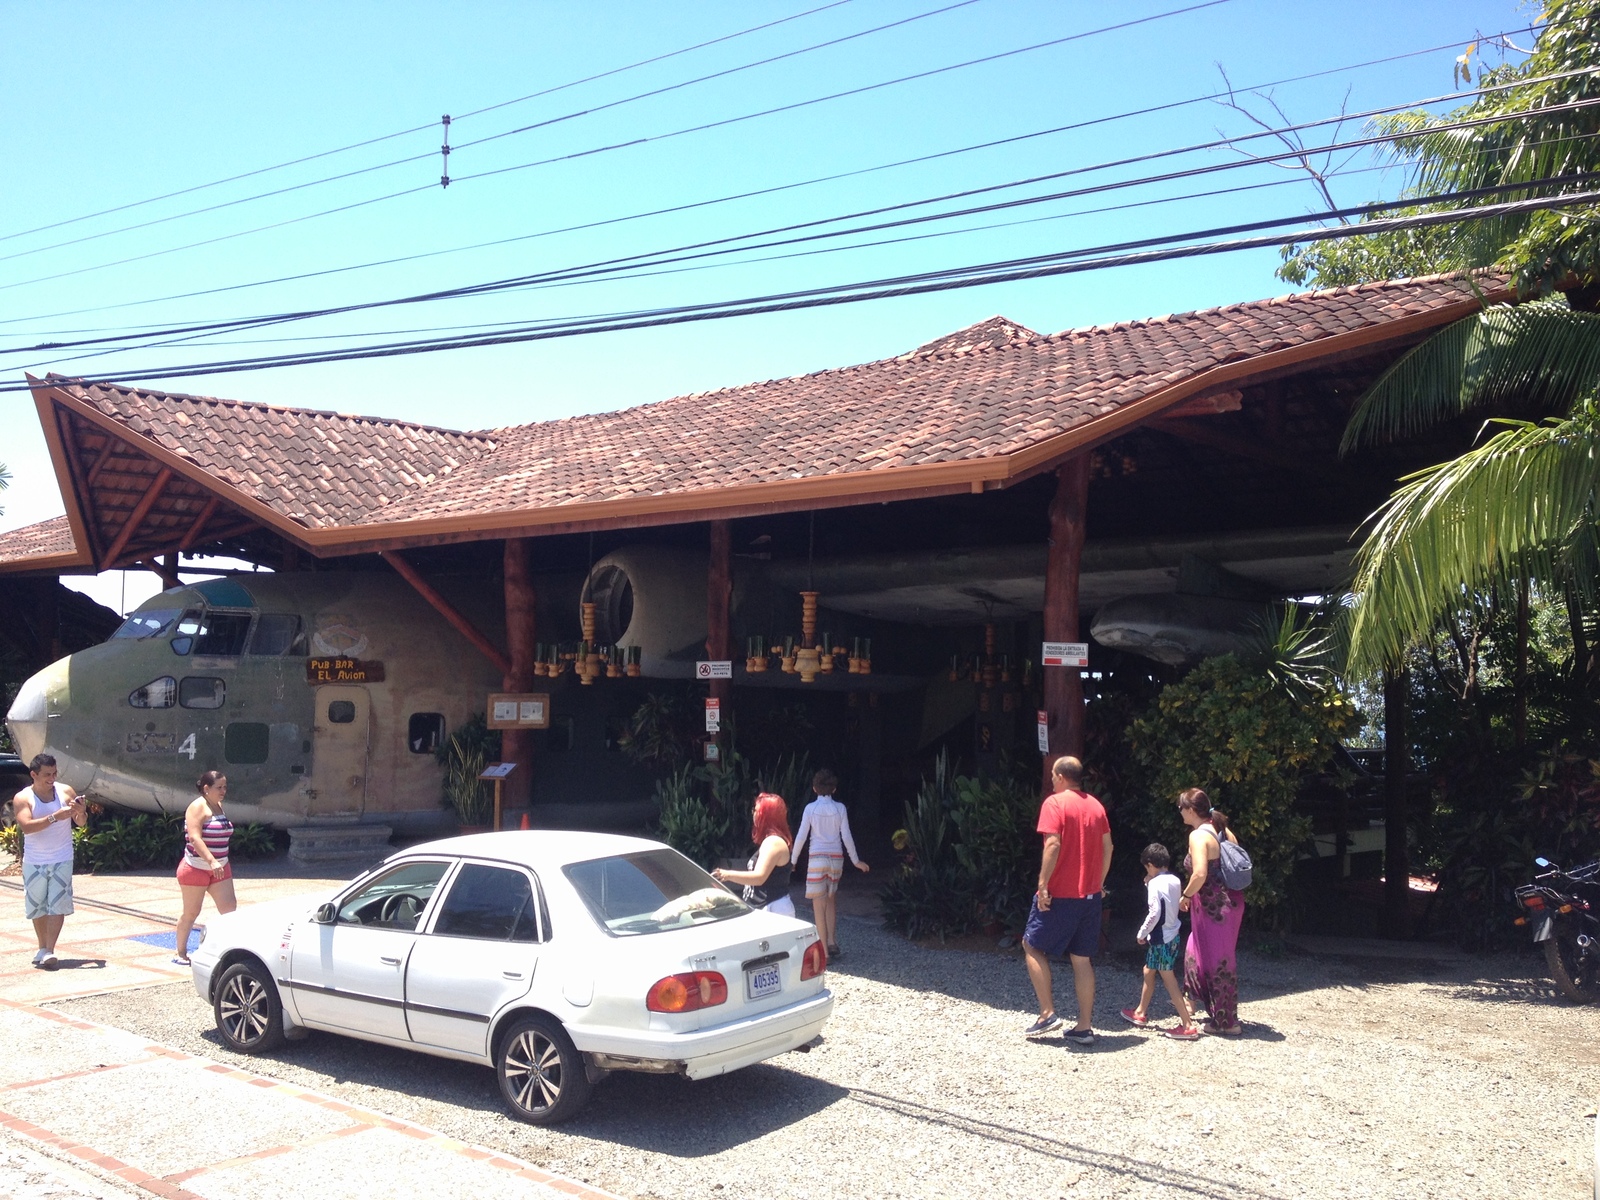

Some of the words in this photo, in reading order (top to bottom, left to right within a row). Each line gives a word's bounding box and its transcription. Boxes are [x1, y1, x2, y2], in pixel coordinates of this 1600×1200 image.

[335, 660, 354, 669] BAR
[318, 671, 331, 680] EL
[178, 732, 197, 760] 4
[753, 970, 779, 989] 405395
